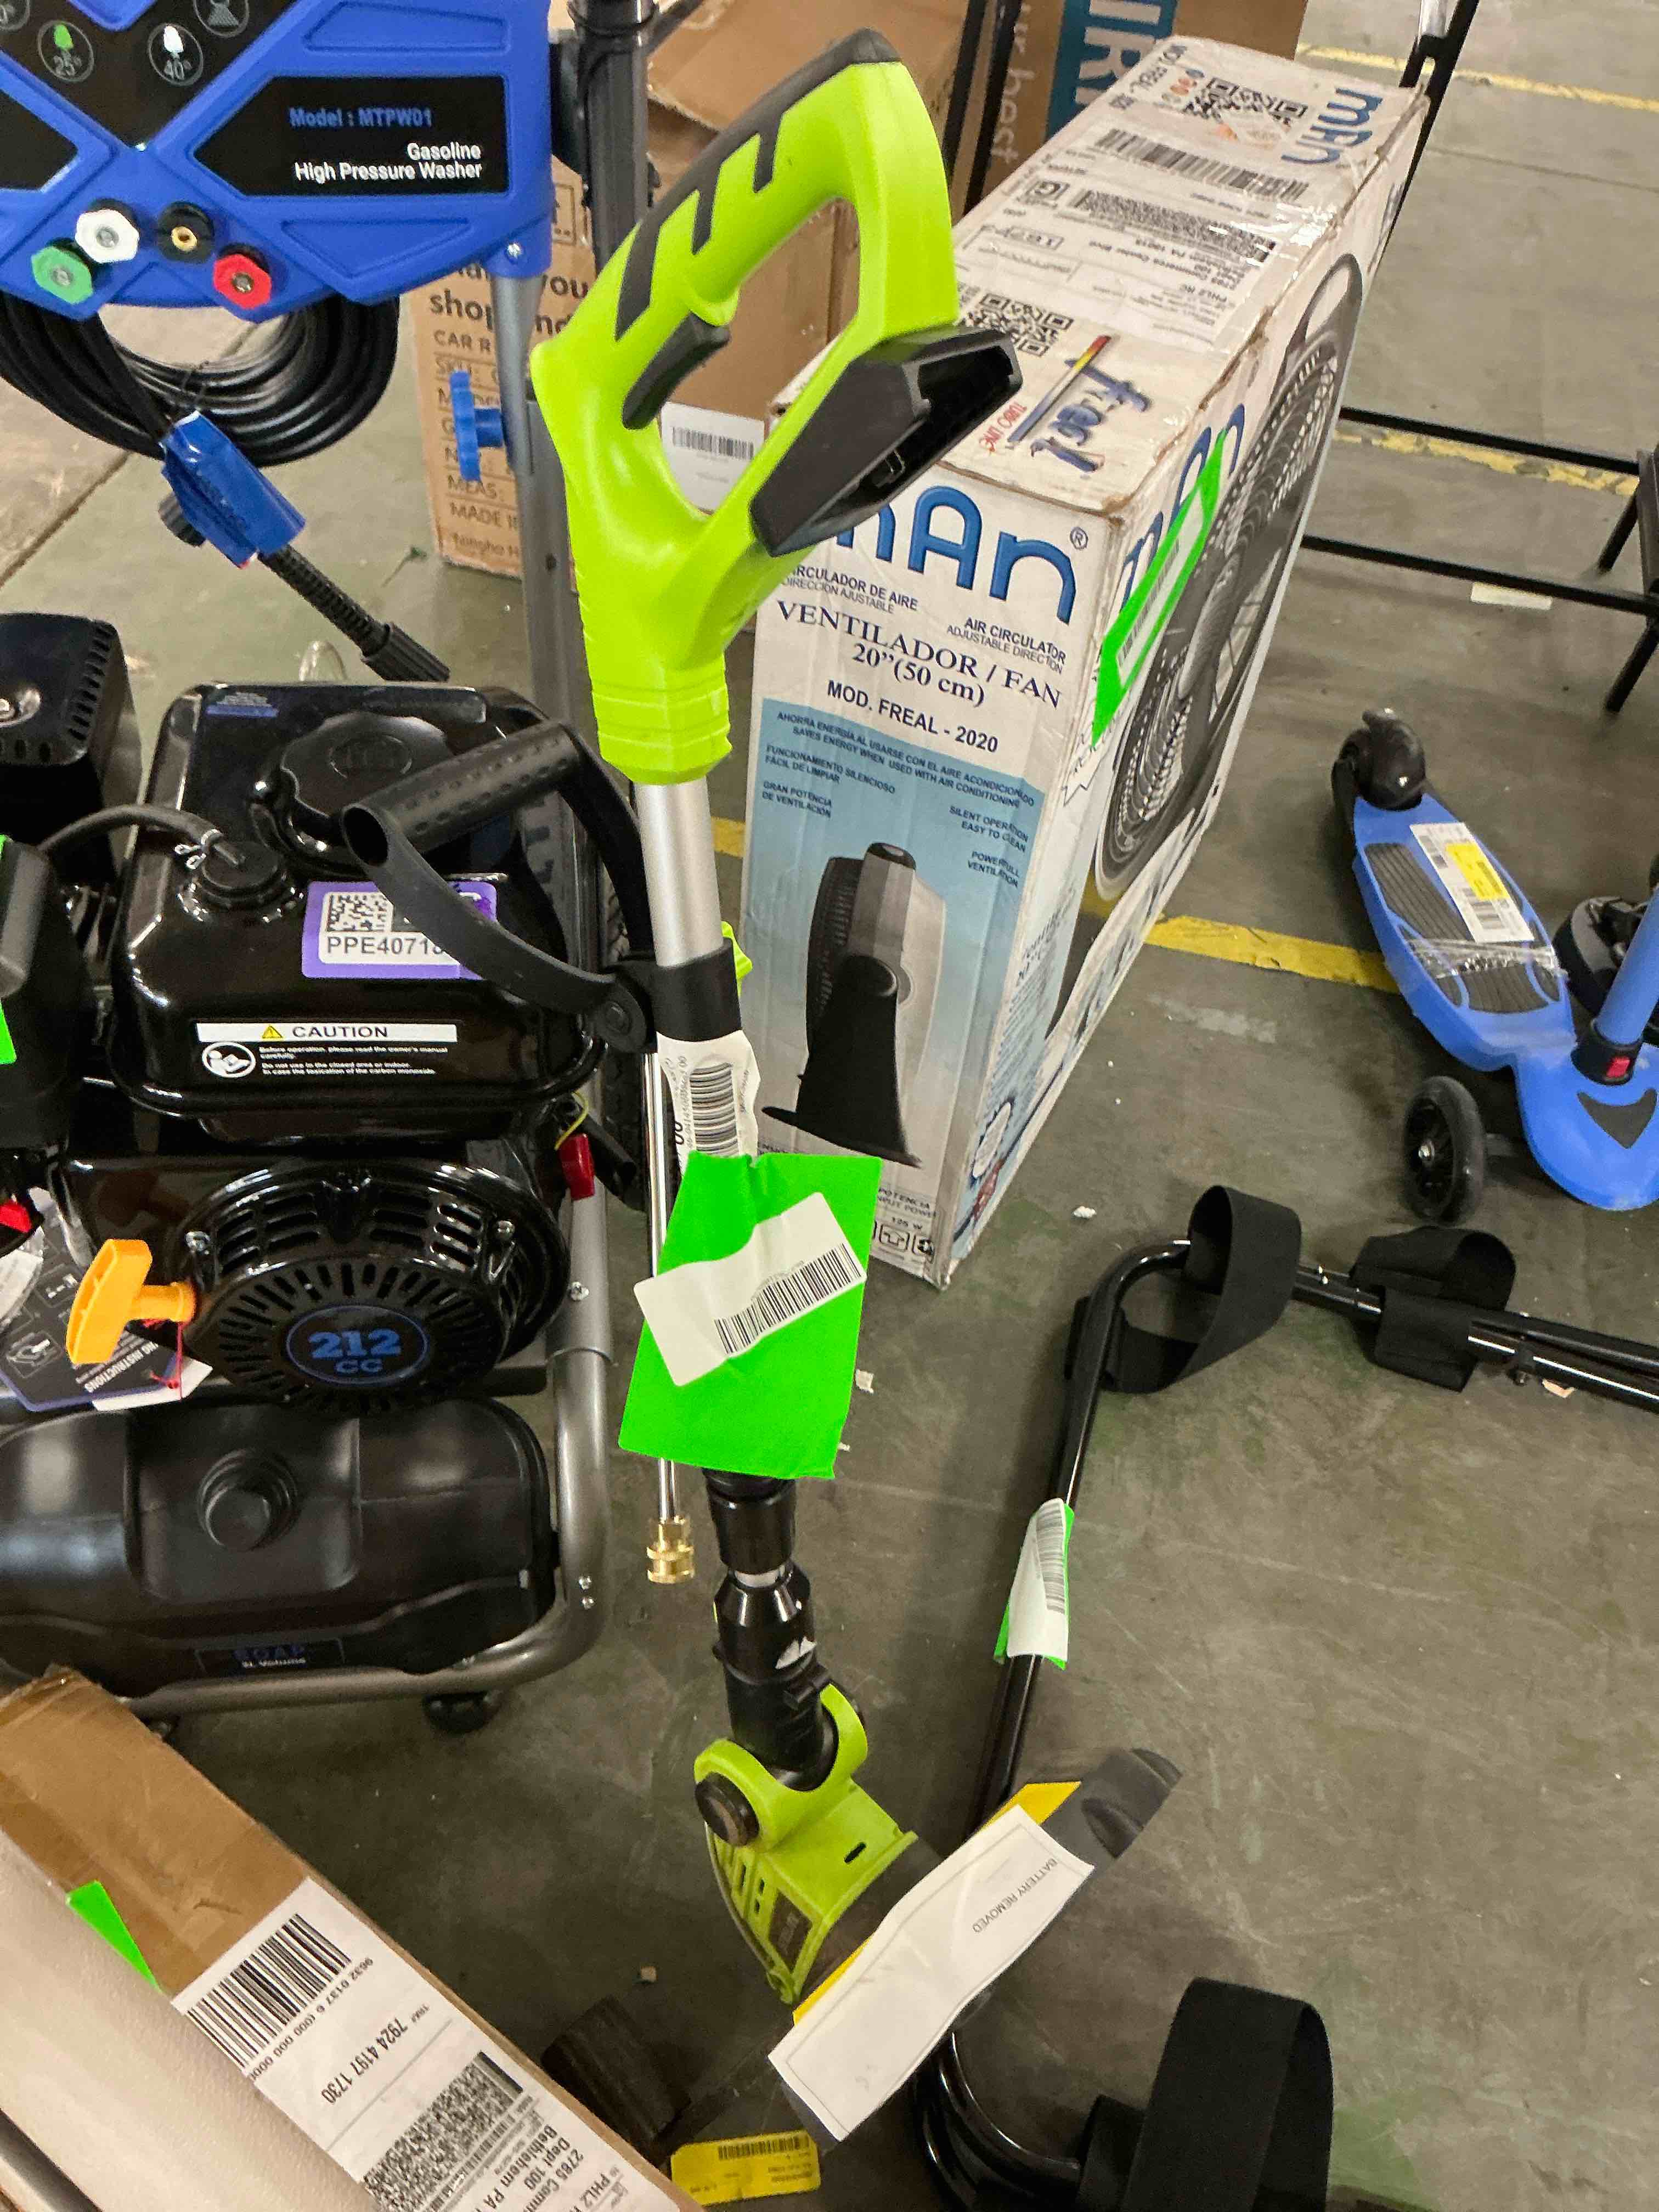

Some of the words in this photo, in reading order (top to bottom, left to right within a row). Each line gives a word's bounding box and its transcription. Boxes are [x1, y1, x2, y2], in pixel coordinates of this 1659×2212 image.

[289, 106, 343, 128] Model
[358, 106, 432, 128] MTPW01
[407, 141, 482, 161] Gasoline
[294, 161, 336, 184] High
[338, 161, 416, 180] Pressure
[417, 160, 483, 180] Washer
[433, 329, 473, 350] CAR
[793, 564, 866, 593] RCULADOR
[870, 584, 887, 599] DE
[889, 591, 918, 611] AIRE
[840, 587, 895, 614] AJUSTABLE
[777, 600, 978, 679] VENTILADOR
[1002, 667, 1063, 710] FAN
[947, 624, 1011, 654] ADJUSTABLE
[1013, 645, 1063, 675] DIRECTION
[964, 616, 987, 634] AIR
[990, 624, 1067, 665] CIRCULATOR
[938, 678, 985, 708] cm)
[827, 680, 873, 712] MOD.
[878, 697, 939, 735] FREAL
[955, 725, 998, 754] 2020
[777, 712, 816, 729] AHORRA
[857, 736, 867, 747] AL
[905, 754, 926, 767] CON
[927, 760, 939, 771] EL
[940, 766, 962, 778] AIRE
[793, 726, 821, 741] SAVES
[823, 734, 859, 754] ENERGY
[860, 748, 885, 765] WHEN
[888, 760, 913, 775] USED
[915, 769, 938, 783] WITH
[938, 776, 955, 789] AIR
[766, 744, 844, 774] FUNCIONAMIENTO
[845, 768, 896, 795] SILENCIOSO
[792, 761, 805, 772] DE
[761, 791, 774, 802] DE
[791, 788, 833, 808] POTENCIA
[949, 804, 982, 822] SILENT
[961, 820, 986, 835] EASY
[988, 829, 1001, 839] TO
[292, 1025, 389, 1040] CAUTION
[308, 1328, 402, 1359] 212
[1017, 1858, 1058, 1897] BATTERY
[972, 1892, 1019, 1933] REMOVED
[376, 2017, 409, 2051] 7924
[349, 2044, 380, 2076] 4197
[321, 2072, 353, 2104] 1730
[499, 2124, 558, 2188] Bethlehem
[523, 2167, 546, 2191] 100
[483, 2186, 505, 2210] PA
